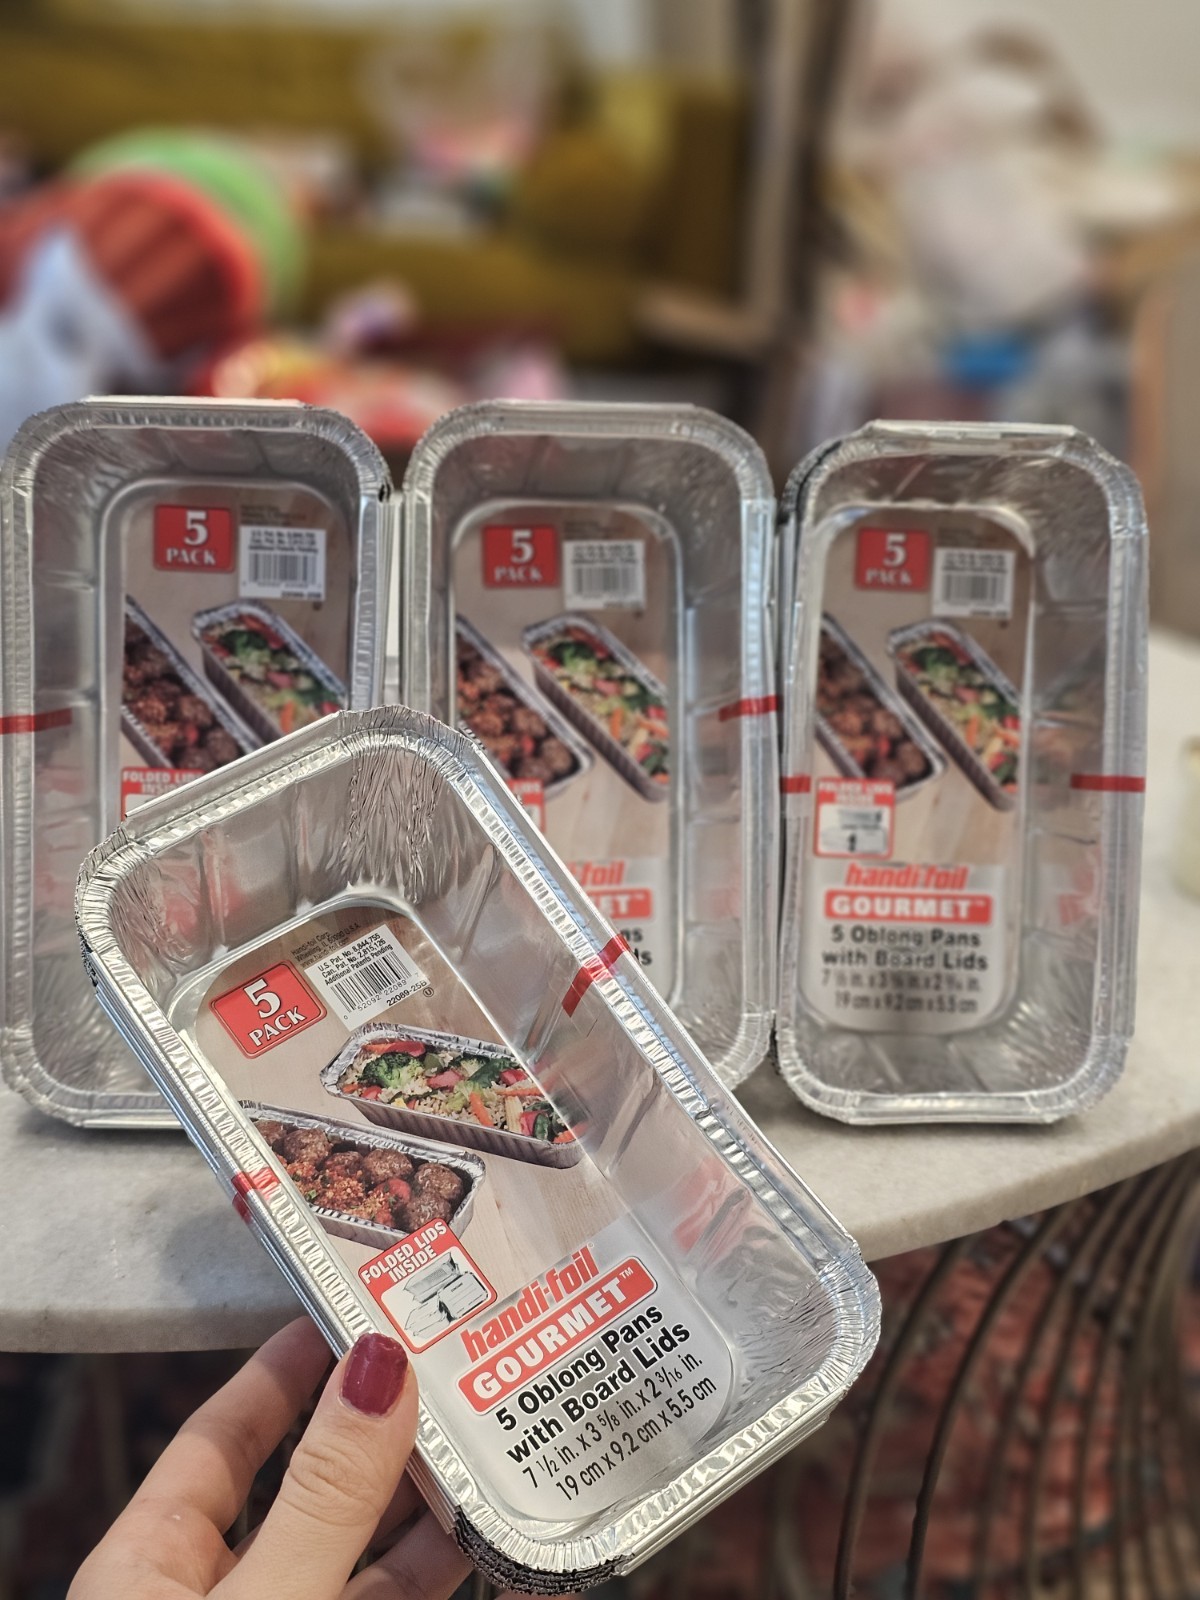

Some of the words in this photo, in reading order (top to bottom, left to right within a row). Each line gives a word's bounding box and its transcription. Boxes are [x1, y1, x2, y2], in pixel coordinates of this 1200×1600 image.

[184, 510, 208, 546] 5
[166, 548, 216, 566] PACK
[511, 529, 534, 564] 5
[883, 533, 906, 567] 5
[494, 565, 543, 582] PACK
[865, 569, 912, 586] PACK
[123, 771, 170, 784] FOLDED
[831, 924, 844, 943] 5
[851, 925, 924, 946] Oblong
[931, 928, 981, 947] Pans
[317, 961, 332, 972] U.S.
[329, 955, 343, 966] Pat.
[341, 950, 354, 959] No.
[321, 969, 337, 979] Can.
[334, 961, 349, 971] Pat.
[346, 955, 359, 964] No.
[324, 966, 352, 987] Additional
[350, 955, 372, 971] Patents
[370, 943, 394, 959] Pending
[822, 951, 868, 966] with
[875, 950, 935, 968] Board
[943, 952, 988, 971] Lids
[243, 977, 282, 1019] 5
[357, 994, 382, 1012] 52092
[383, 979, 408, 996] 22089
[248, 1006, 307, 1047] PACK
[360, 1243, 414, 1284] FOLDED
[413, 1221, 447, 1249] LIDS
[388, 1244, 437, 1283] INSIDE
[495, 1406, 517, 1431] 5
[517, 1347, 606, 1415] Oblong
[600, 1305, 663, 1355] Pans
[505, 1416, 565, 1464] with
[560, 1358, 637, 1423] Board
[632, 1322, 690, 1370] Lids
[522, 1466, 538, 1489] 7
[553, 1443, 580, 1465] in.
[575, 1434, 592, 1451] x
[585, 1421, 602, 1443] 3
[615, 1399, 641, 1420] in.
[635, 1389, 651, 1407] x
[644, 1377, 662, 1399] 2
[677, 1353, 703, 1373] in.
[556, 1474, 579, 1501] 19
[579, 1461, 605, 1487] cm
[600, 1452, 617, 1471] x
[609, 1431, 640, 1461] 9.2
[636, 1418, 662, 1443] cm
[657, 1410, 674, 1428] x
[666, 1388, 695, 1419] 5.5
[692, 1377, 717, 1401] cm
